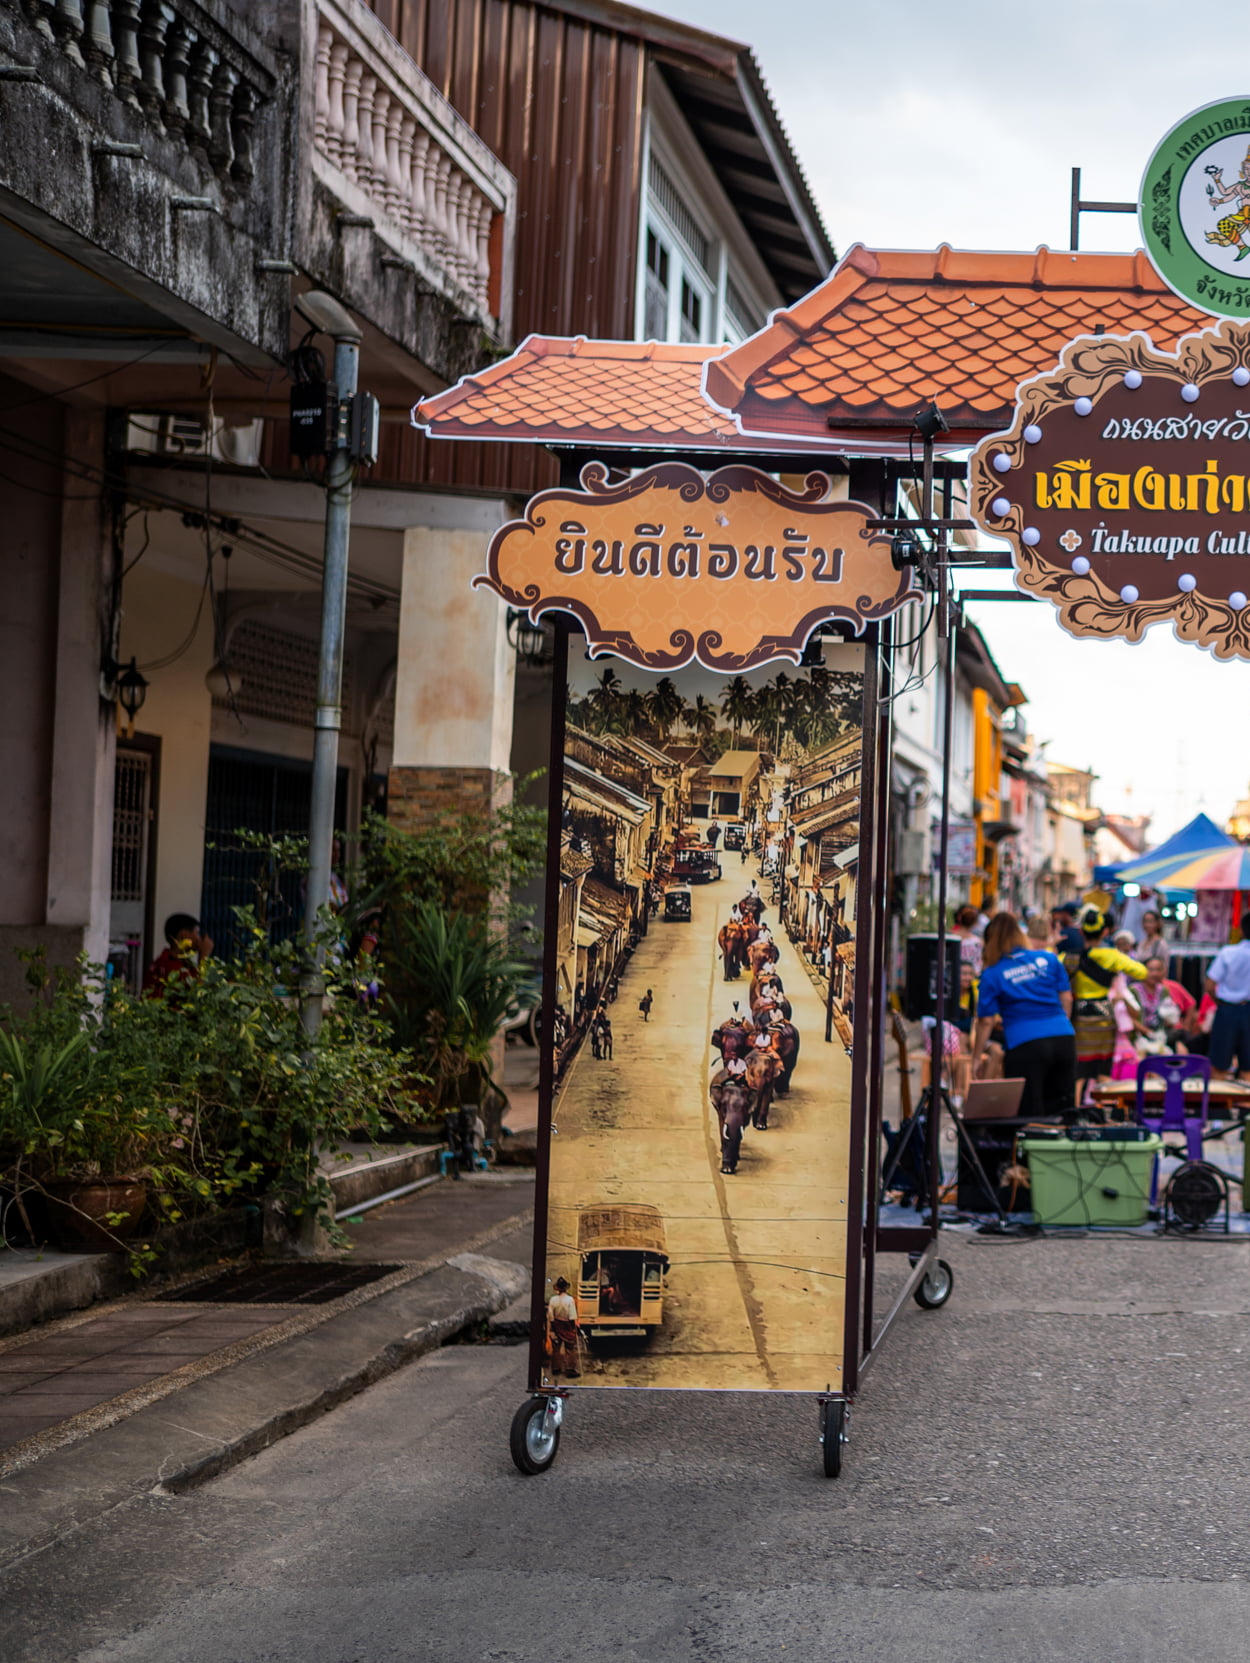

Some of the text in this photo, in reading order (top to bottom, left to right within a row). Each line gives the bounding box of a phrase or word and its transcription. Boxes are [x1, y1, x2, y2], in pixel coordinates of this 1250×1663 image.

[553, 520, 846, 584] ยินดีต้อนรับ
[1091, 527, 1201, 561] Takuapa
